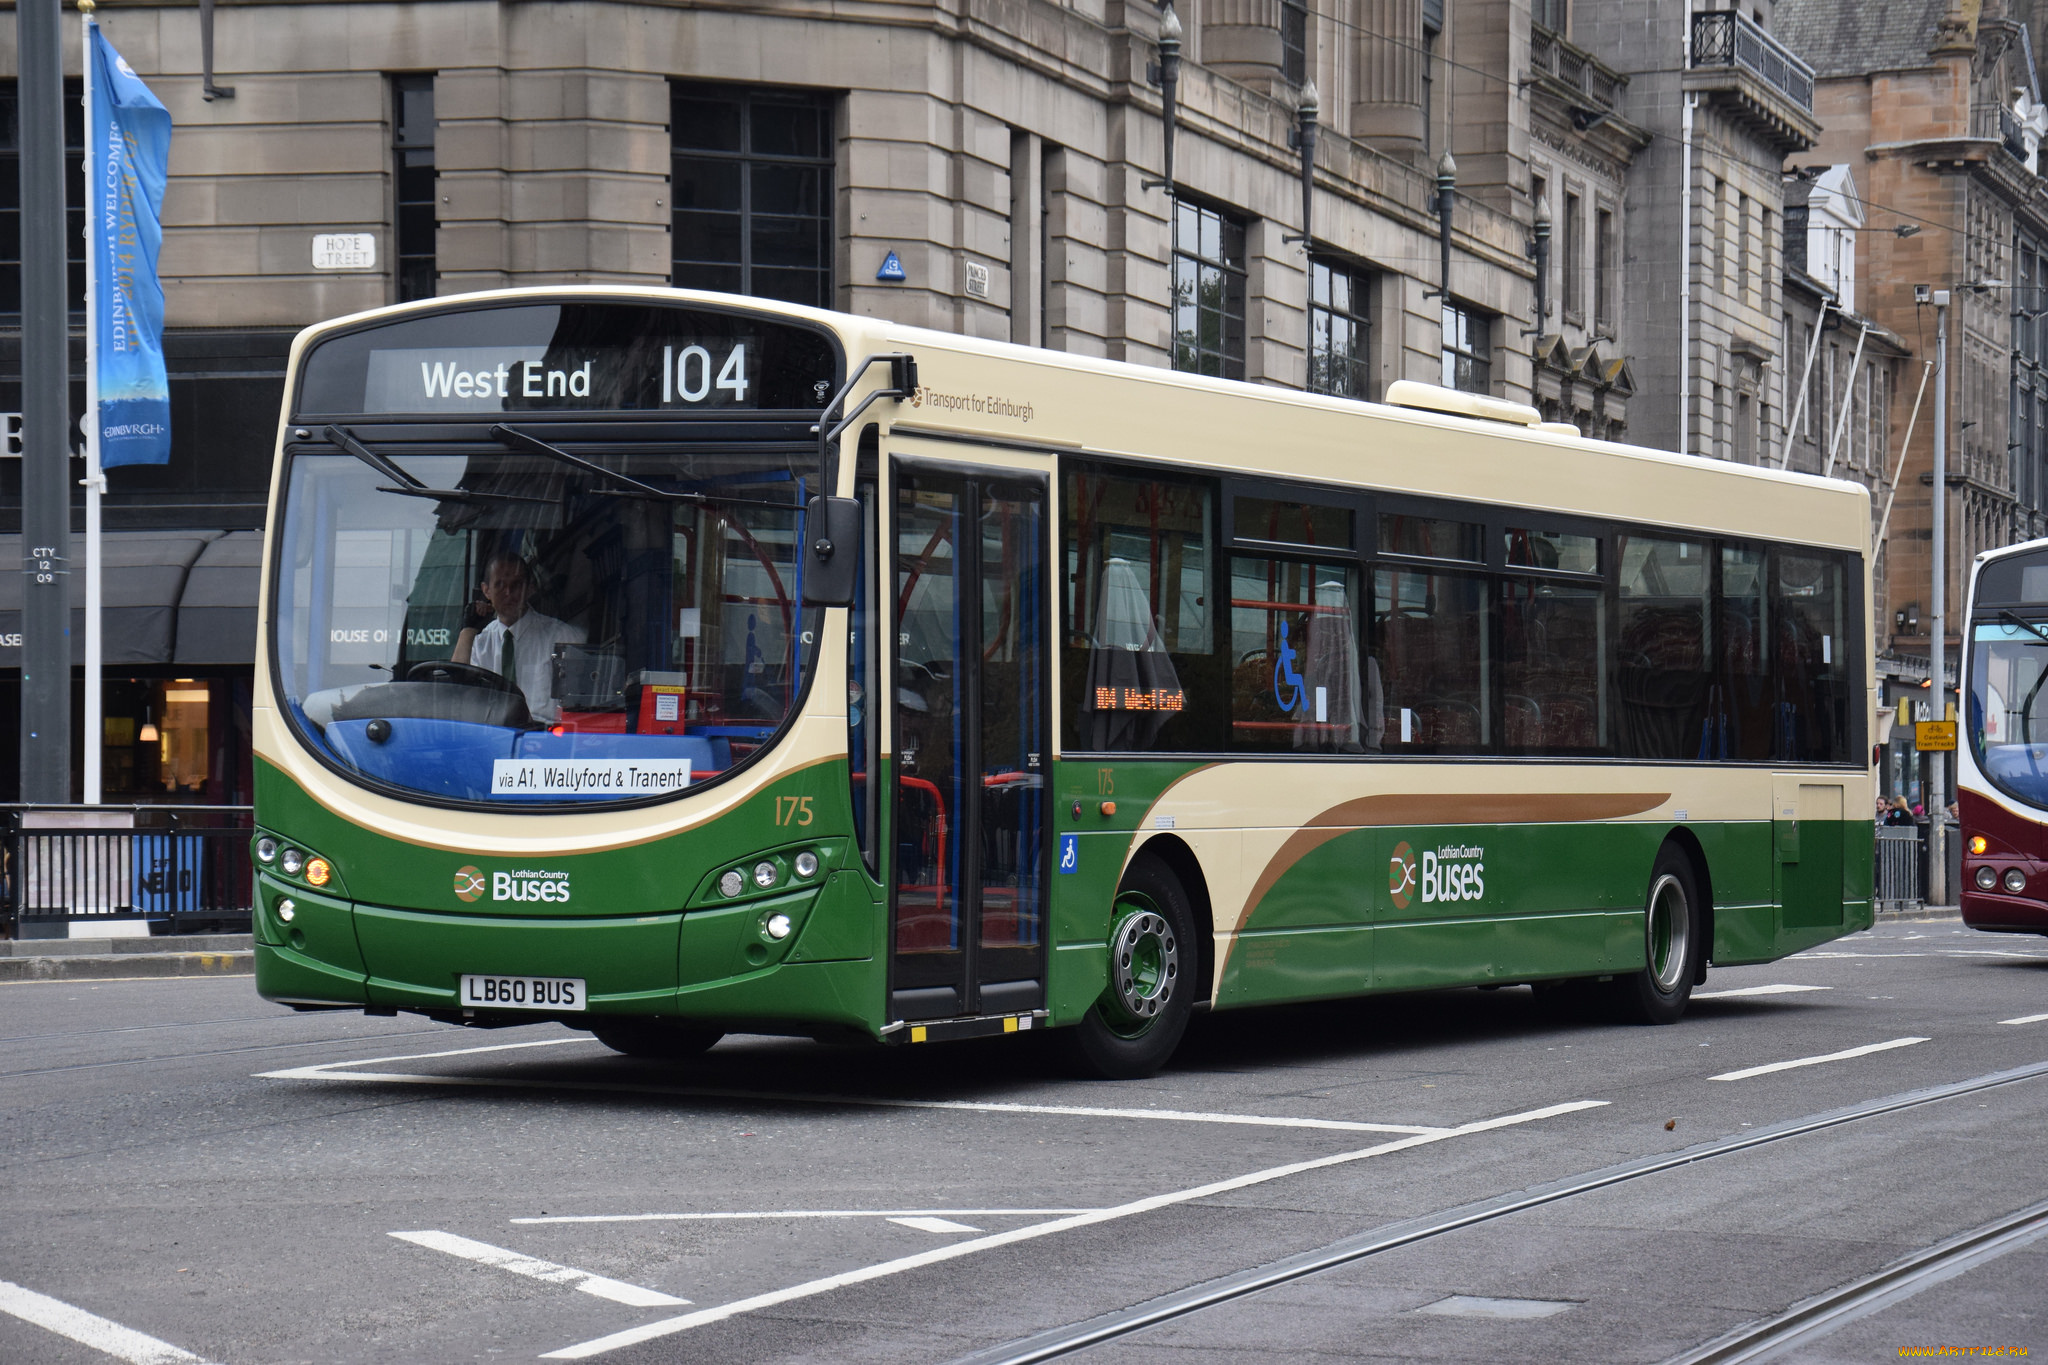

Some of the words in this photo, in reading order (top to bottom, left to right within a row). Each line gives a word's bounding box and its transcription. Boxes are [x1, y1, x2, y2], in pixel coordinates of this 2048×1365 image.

[119, 174, 137, 247] RYDER
[326, 237, 361, 250] HOPE
[319, 251, 369, 265] STREET
[117, 253, 135, 300] 2014
[107, 235, 126, 352] EDINBH
[421, 361, 509, 398] West
[523, 361, 590, 397] End
[663, 343, 749, 402] 104
[924, 386, 970, 412] Transport
[971, 393, 985, 413] for
[987, 396, 1034, 422] Edinburgh
[33, 547, 55, 558] CTY
[39, 560, 50, 570] 12
[37, 573, 53, 583] 09
[1096, 687, 1117, 709] 104
[1124, 688, 1157, 710] West
[1159, 689, 1182, 711] End
[499, 772, 513, 787] via
[517, 767, 537, 789] A1,
[544, 767, 612, 792] Wallyford
[615, 771, 624, 787] &
[629, 767, 682, 788] Tranent
[1098, 768, 1114, 795] 175
[775, 796, 813, 826] 175
[1438, 845, 1460, 859] Lothian
[1460, 844, 1484, 860] Country
[492, 872, 570, 902] Buses
[511, 869, 538, 878] Lothian
[539, 870, 569, 880] Country
[1421, 851, 1484, 903] Buses
[470, 978, 526, 1002] LB60
[533, 981, 575, 1004] BUS
